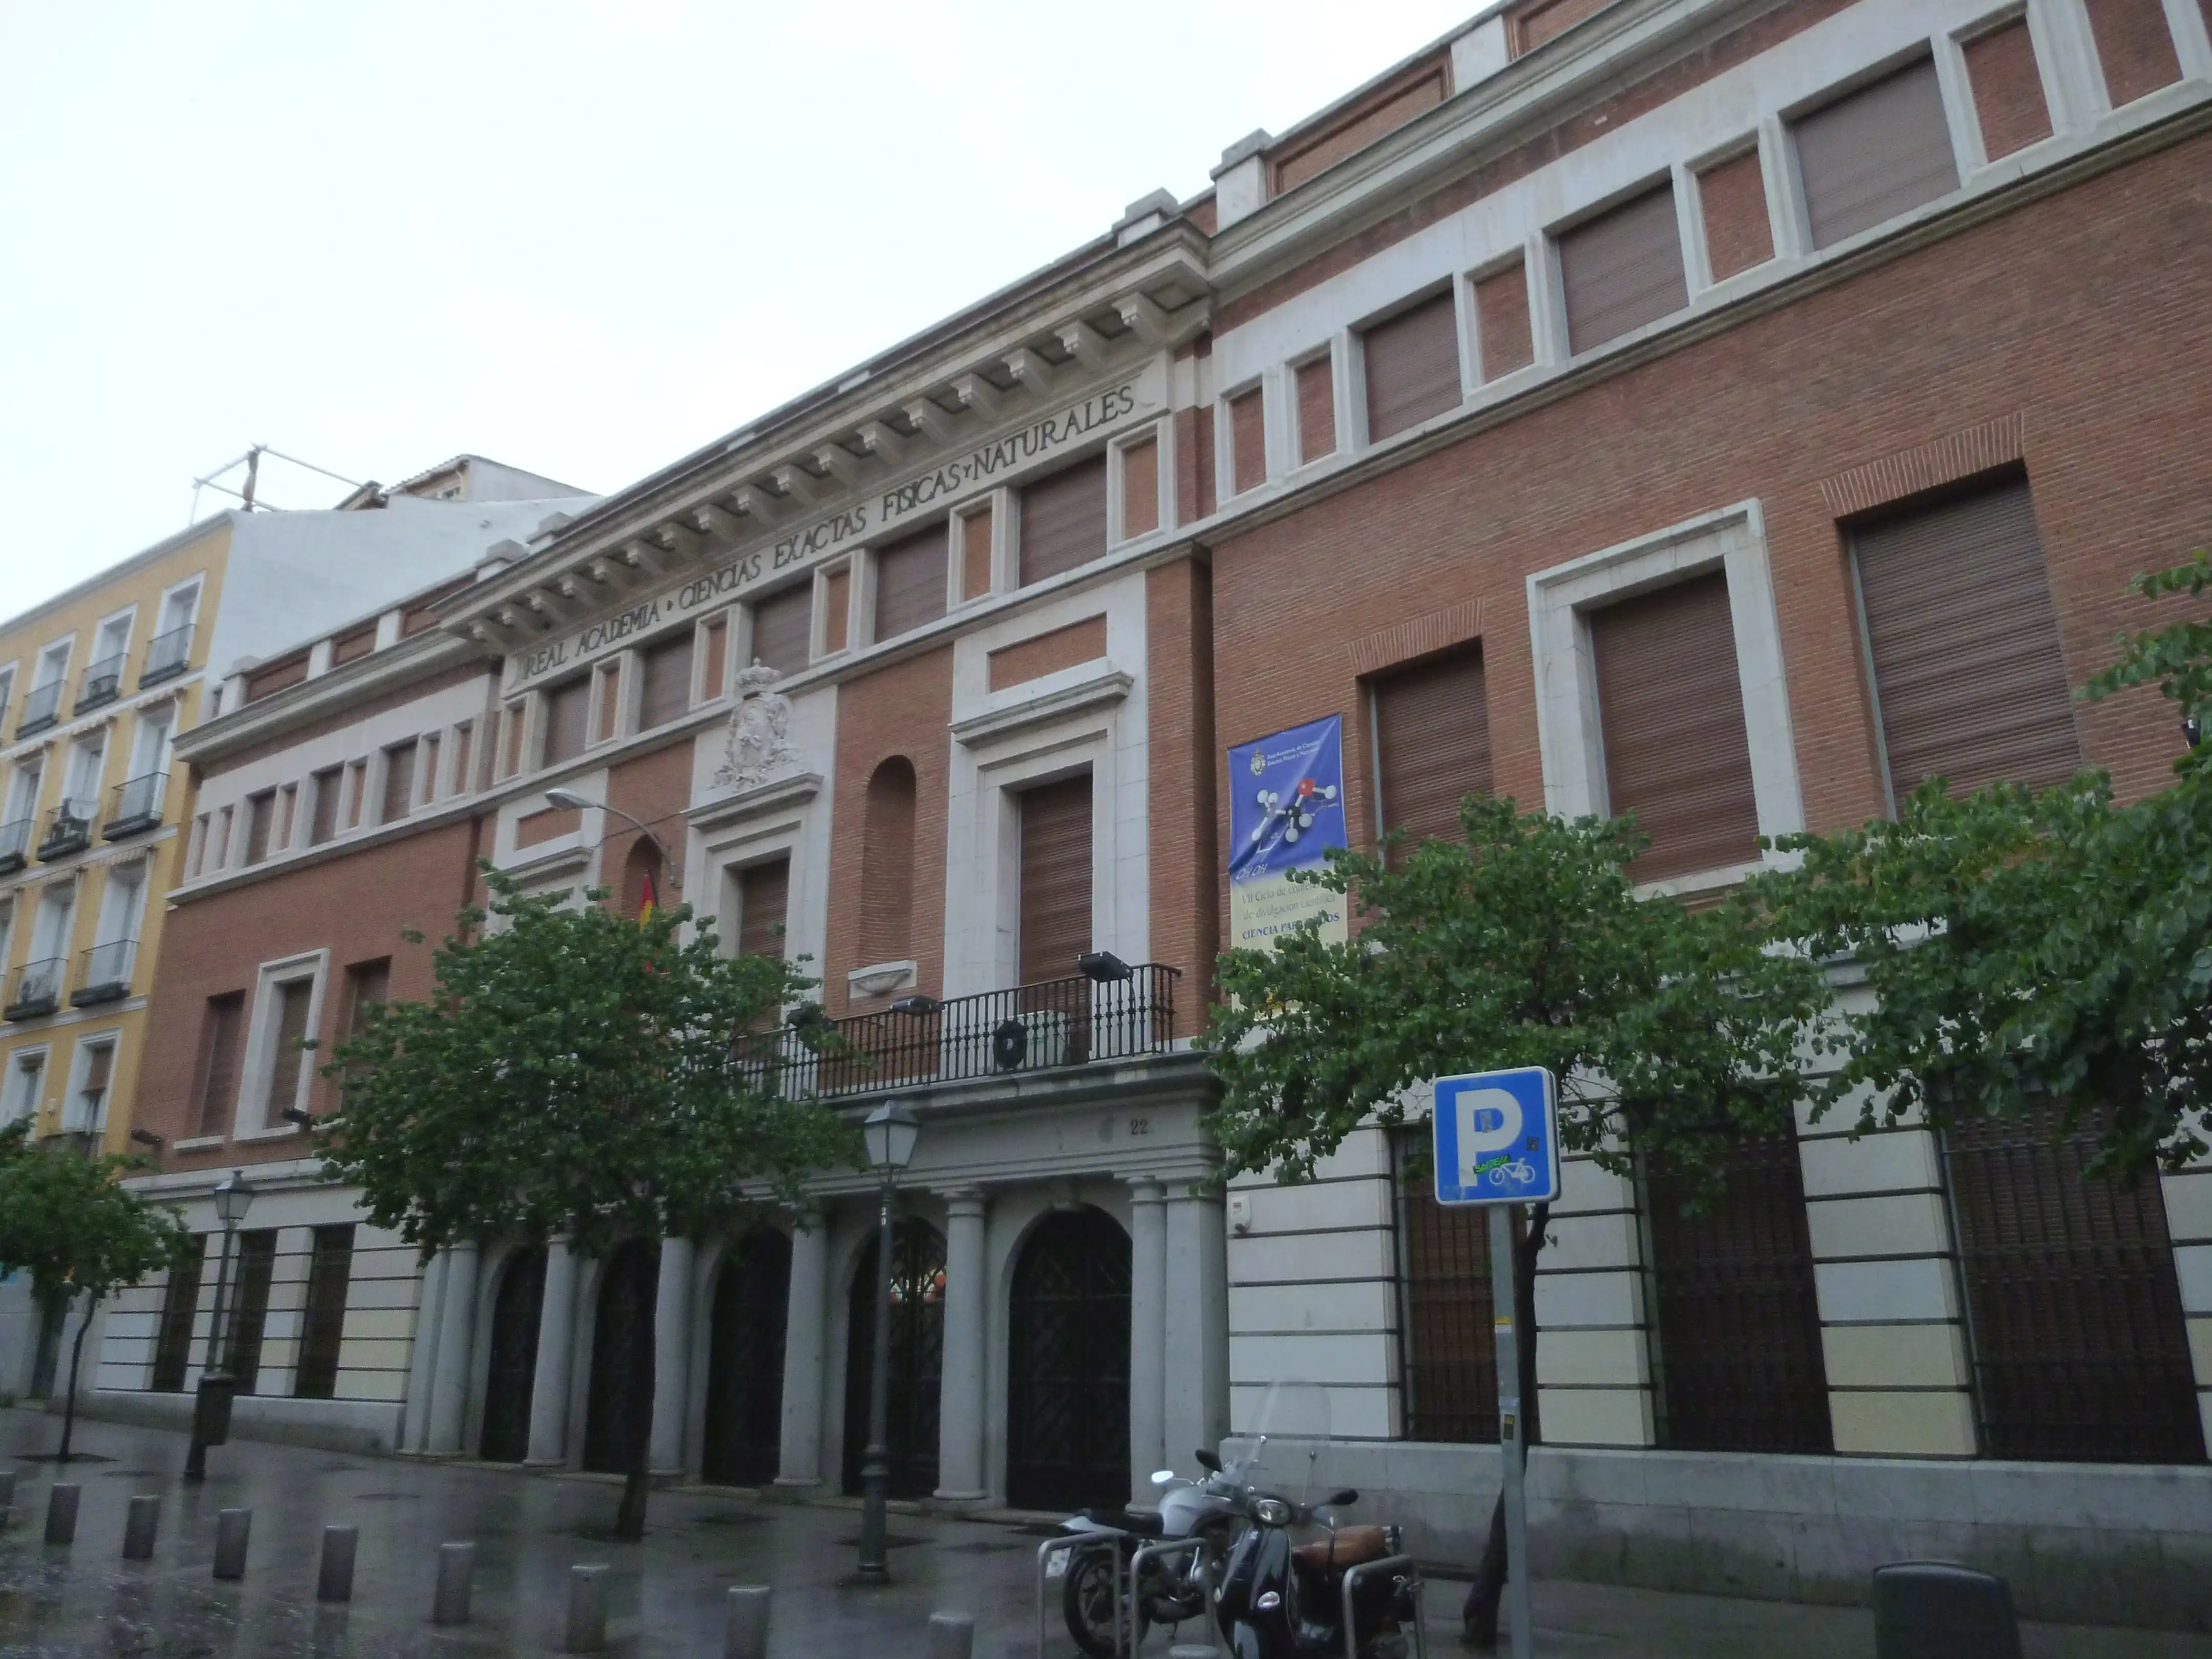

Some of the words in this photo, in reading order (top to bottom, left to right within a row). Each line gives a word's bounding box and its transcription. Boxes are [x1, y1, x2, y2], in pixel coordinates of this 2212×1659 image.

[522, 641, 568, 680] REAL
[575, 600, 661, 657] ACADEMIA
[678, 554, 762, 610] CIENCIAS
[773, 506, 866, 570] EXACTAS
[881, 463, 961, 522] FISICAS
[973, 386, 1134, 480] NATURALES
[1256, 889, 1274, 902] Ciclo
[1277, 884, 1286, 896] de
[1243, 909, 1254, 920] de
[1256, 900, 1299, 918] divulgación
[1242, 925, 1279, 940] CIENCIA
[1281, 920, 1303, 932] PAR
[1131, 1119, 1148, 1135] 22
[1455, 1088, 1522, 1187] P
